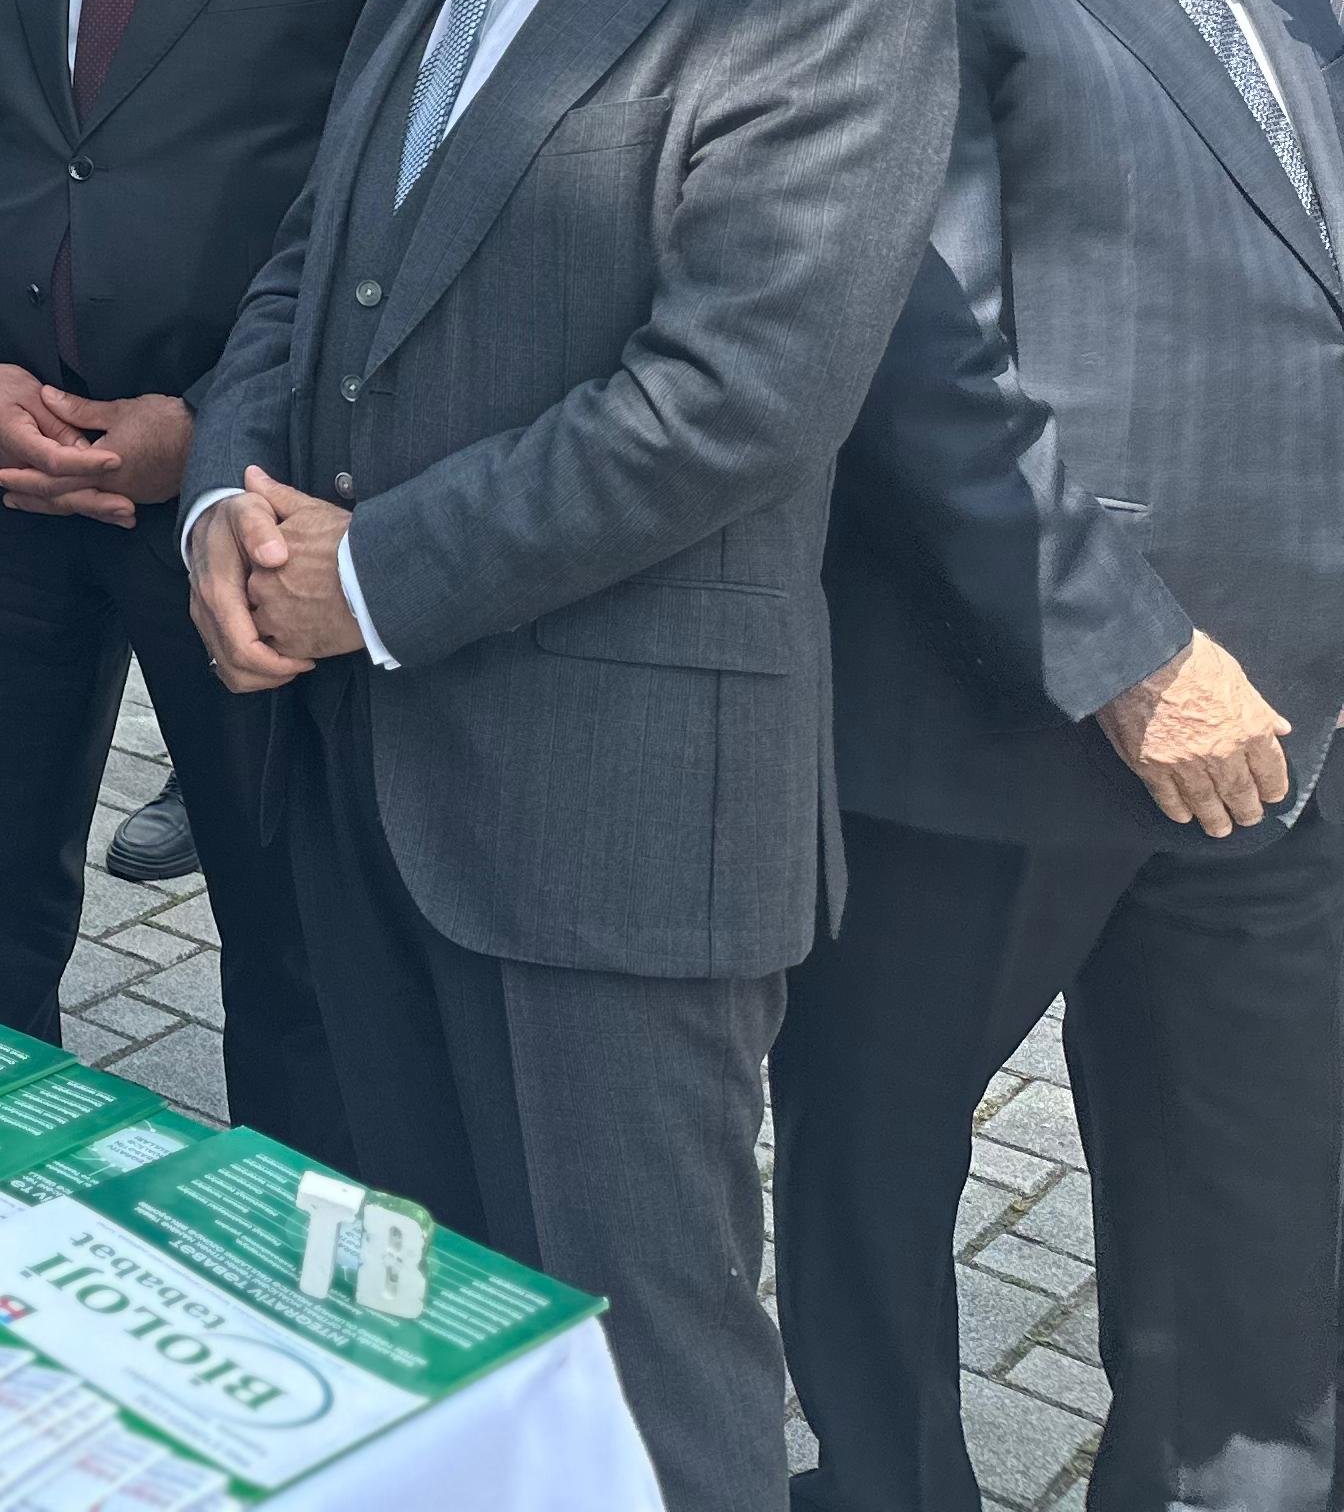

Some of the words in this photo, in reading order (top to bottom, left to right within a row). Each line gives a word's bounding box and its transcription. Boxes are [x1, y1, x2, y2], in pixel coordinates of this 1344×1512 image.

[69, 1231, 226, 1331] təbabət
[167, 1236, 252, 1290] TƏBABƏT
[19, 1251, 288, 1411] BİOLOJİ
[247, 1282, 350, 1347] İNTEQRATİV
